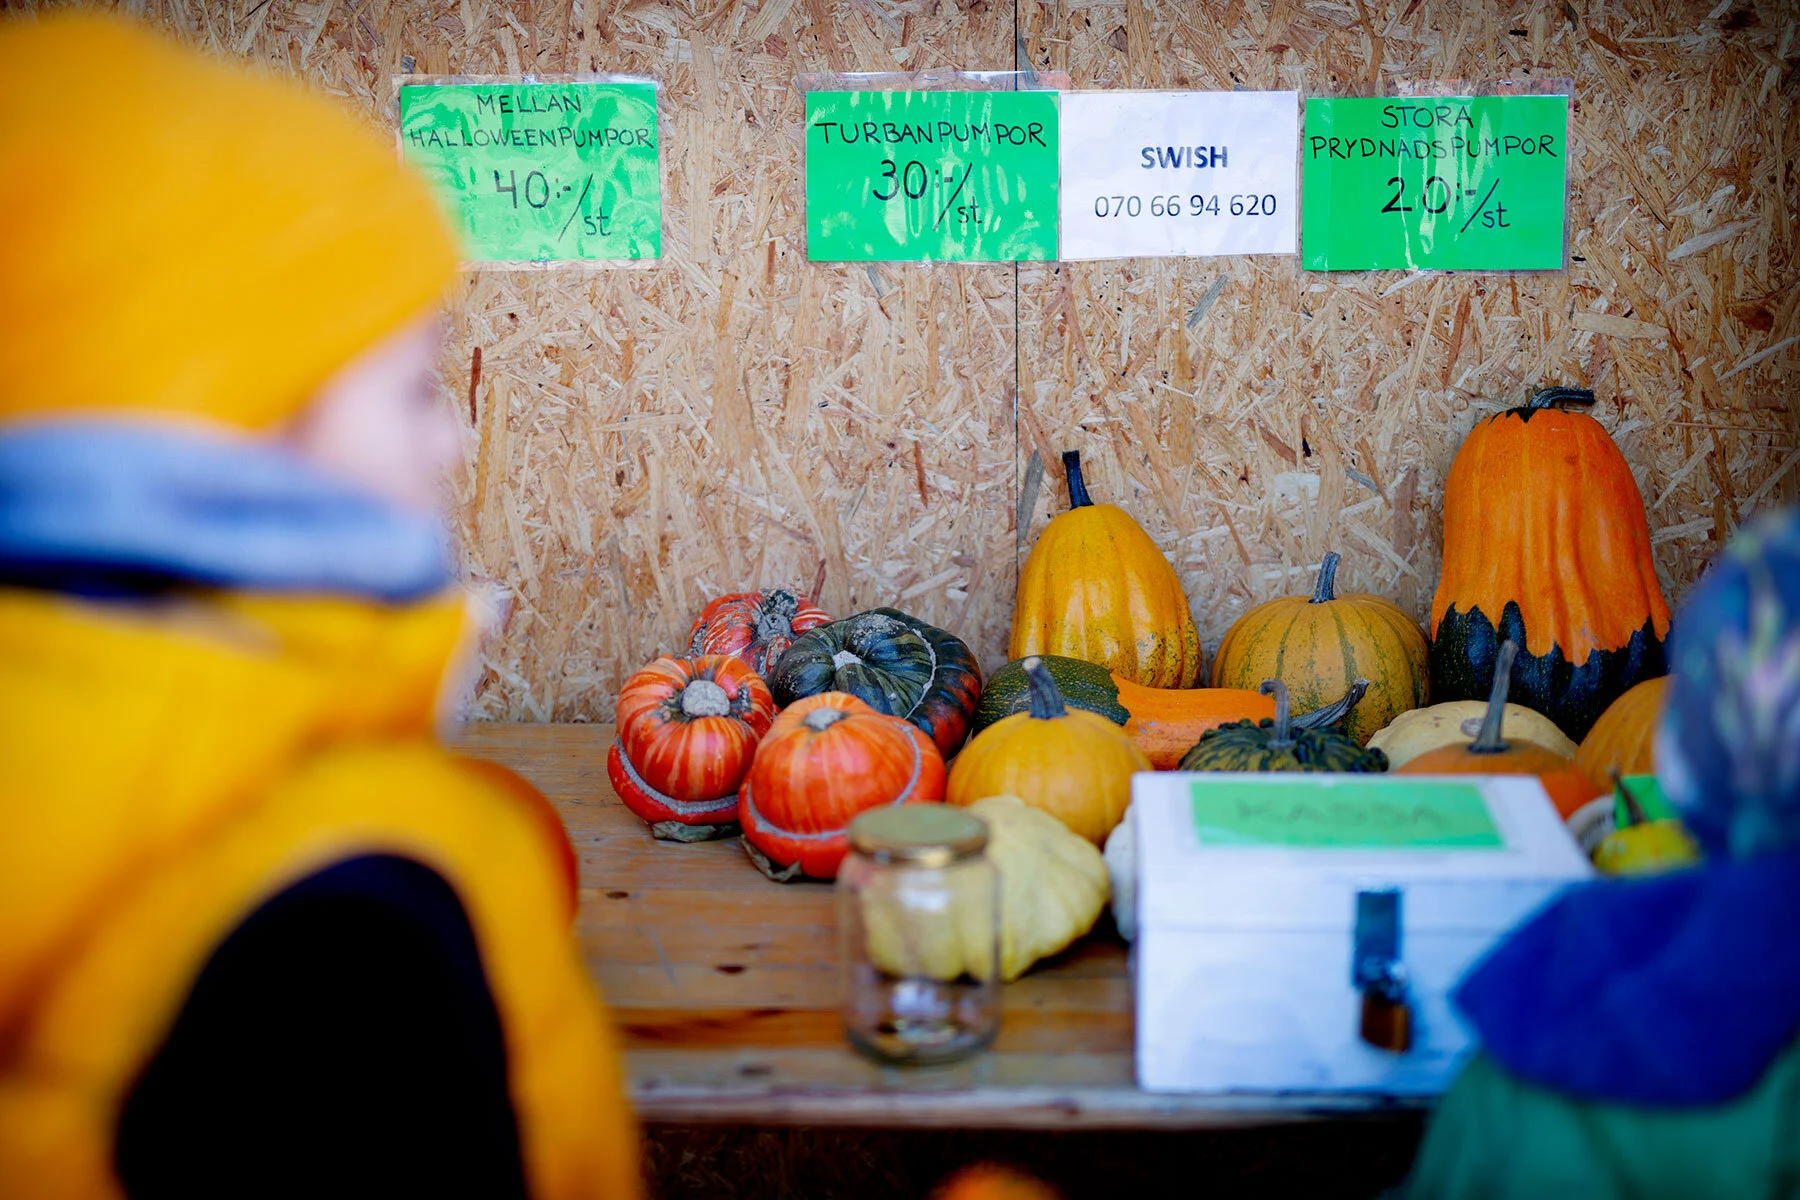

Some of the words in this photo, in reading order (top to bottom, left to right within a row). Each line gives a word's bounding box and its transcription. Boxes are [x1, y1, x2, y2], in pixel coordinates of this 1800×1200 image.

[477, 94, 581, 115] MELLAN
[1381, 105, 1474, 128] STORA
[410, 126, 654, 149] HALLOWEENPUMPOR
[814, 122, 1047, 147] TURBANPUMPOR
[1141, 146, 1228, 169] SWISH
[1310, 135, 1557, 159] PRYDNADSPUMPOR
[1094, 195, 1141, 217] 070
[1151, 195, 1181, 216] 66
[1190, 194, 1220, 216] 94
[1230, 194, 1277, 216] 620
